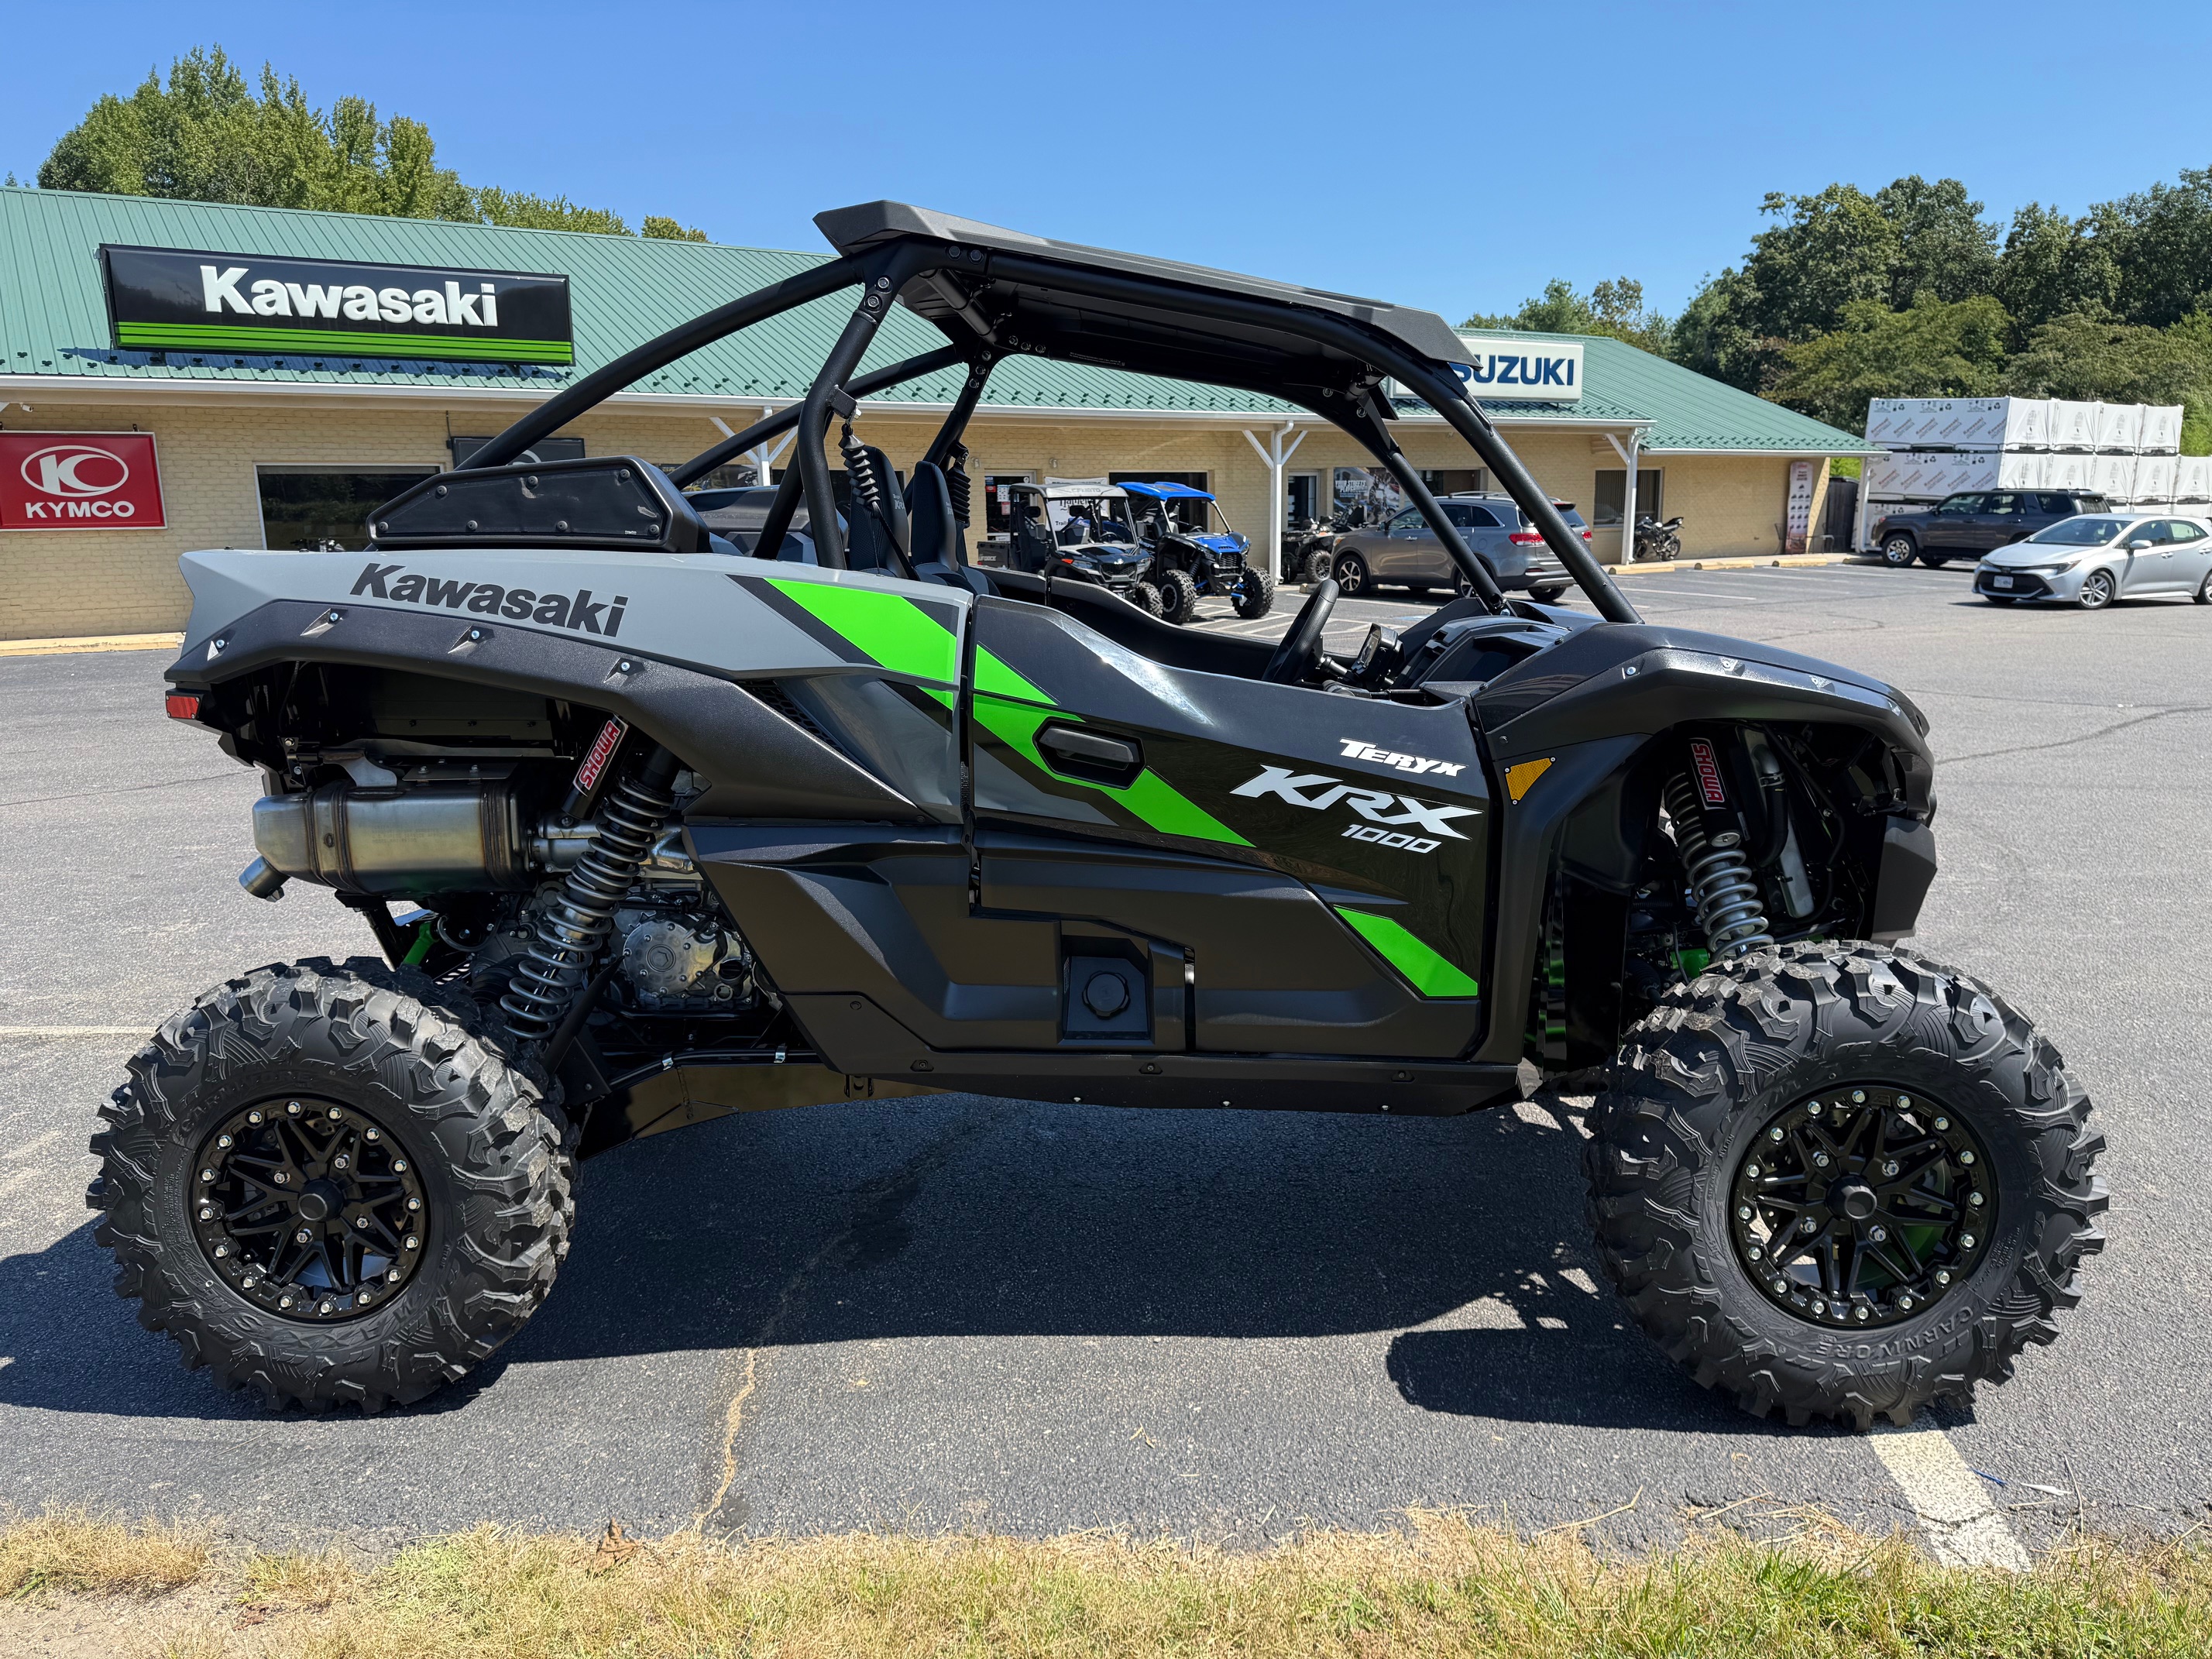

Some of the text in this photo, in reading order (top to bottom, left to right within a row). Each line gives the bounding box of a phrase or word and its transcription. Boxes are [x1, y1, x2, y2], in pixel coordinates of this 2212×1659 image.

[200, 265, 498, 327] Kawasaki
[26, 501, 135, 518] KYMCO
[349, 563, 629, 637] Kawasaki
[579, 720, 621, 791] SHOWA
[1691, 743, 1725, 802] SHOWA
[1229, 763, 1483, 841] KRX
[1341, 824, 1442, 854] 1000
[1815, 1306, 1974, 1360] CARNIVORE
